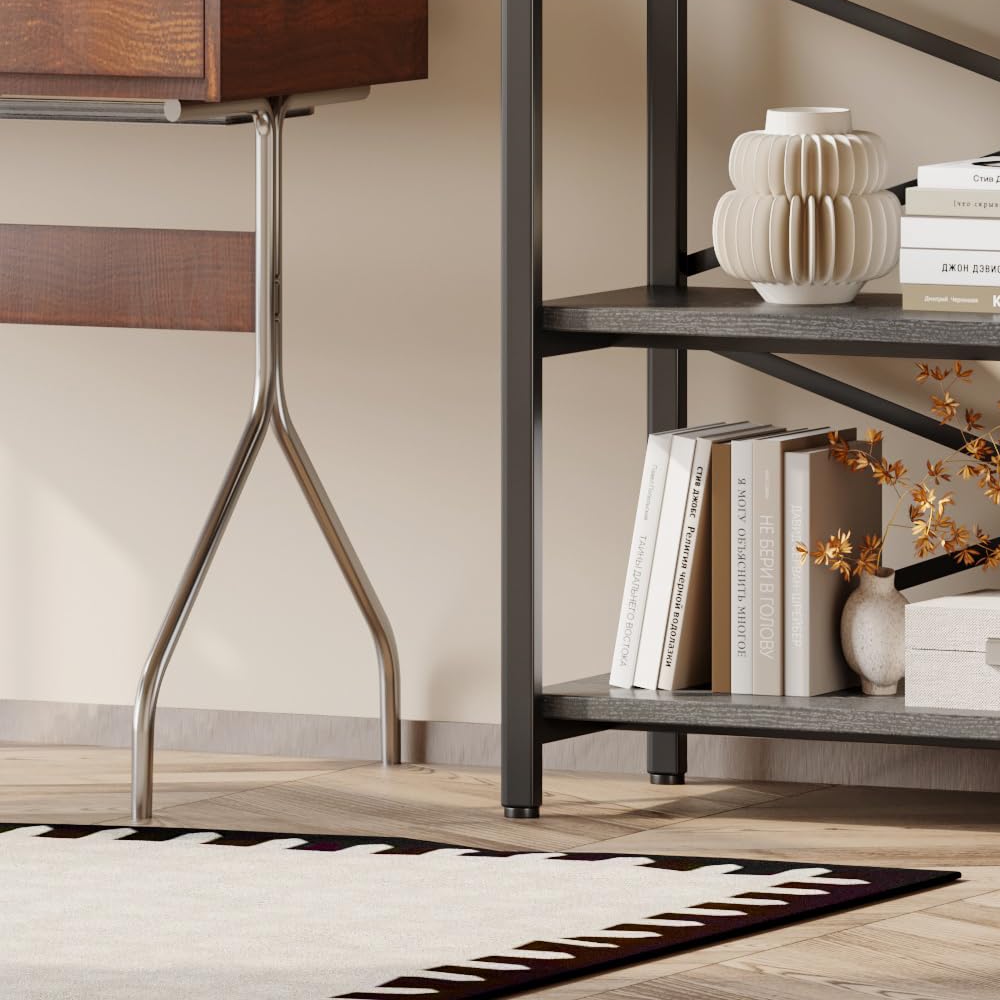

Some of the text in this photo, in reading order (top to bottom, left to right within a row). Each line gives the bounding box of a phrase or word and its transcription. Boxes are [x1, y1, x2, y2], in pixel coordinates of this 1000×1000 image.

[972, 174, 994, 184] Стив
[942, 263, 969, 273] ДЖОН
[737, 489, 747, 522] МОГУ
[760, 515, 774, 537] НЕ
[737, 529, 747, 602] ОБЪЯСНИТЬ
[760, 540, 774, 579] БЕРИ
[628, 566, 643, 621] ДАЛЬНЕГО
[665, 526, 695, 668] Религия черной водолазки
[760, 584, 774, 593] В
[619, 621, 633, 667] ВОСТОКА
[737, 606, 747, 658] МНОГОЕ
[760, 597, 774, 660] ГОЛОВУ
